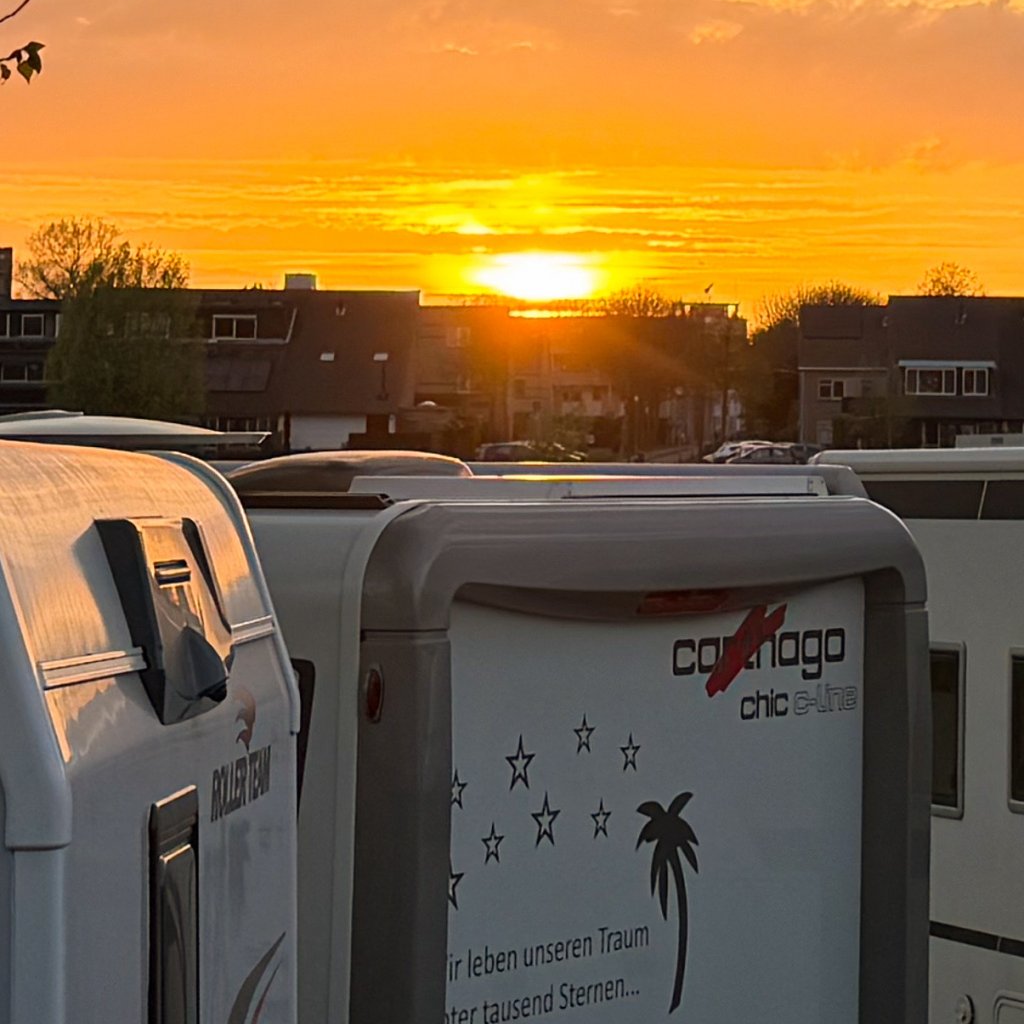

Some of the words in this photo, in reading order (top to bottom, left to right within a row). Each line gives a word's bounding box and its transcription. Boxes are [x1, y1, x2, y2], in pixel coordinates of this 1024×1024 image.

[672, 626, 846, 681] cahago
[740, 688, 789, 721] chic
[793, 682, 858, 716] c-line
[210, 756, 247, 823] ROLLER
[247, 745, 271, 804] TEAM
[448, 953, 463, 982] ir
[467, 945, 518, 979] leben
[523, 936, 593, 968] unseren
[598, 925, 650, 955] Traum
[483, 984, 554, 1024] tausend
[559, 978, 640, 1011] Sternen...
